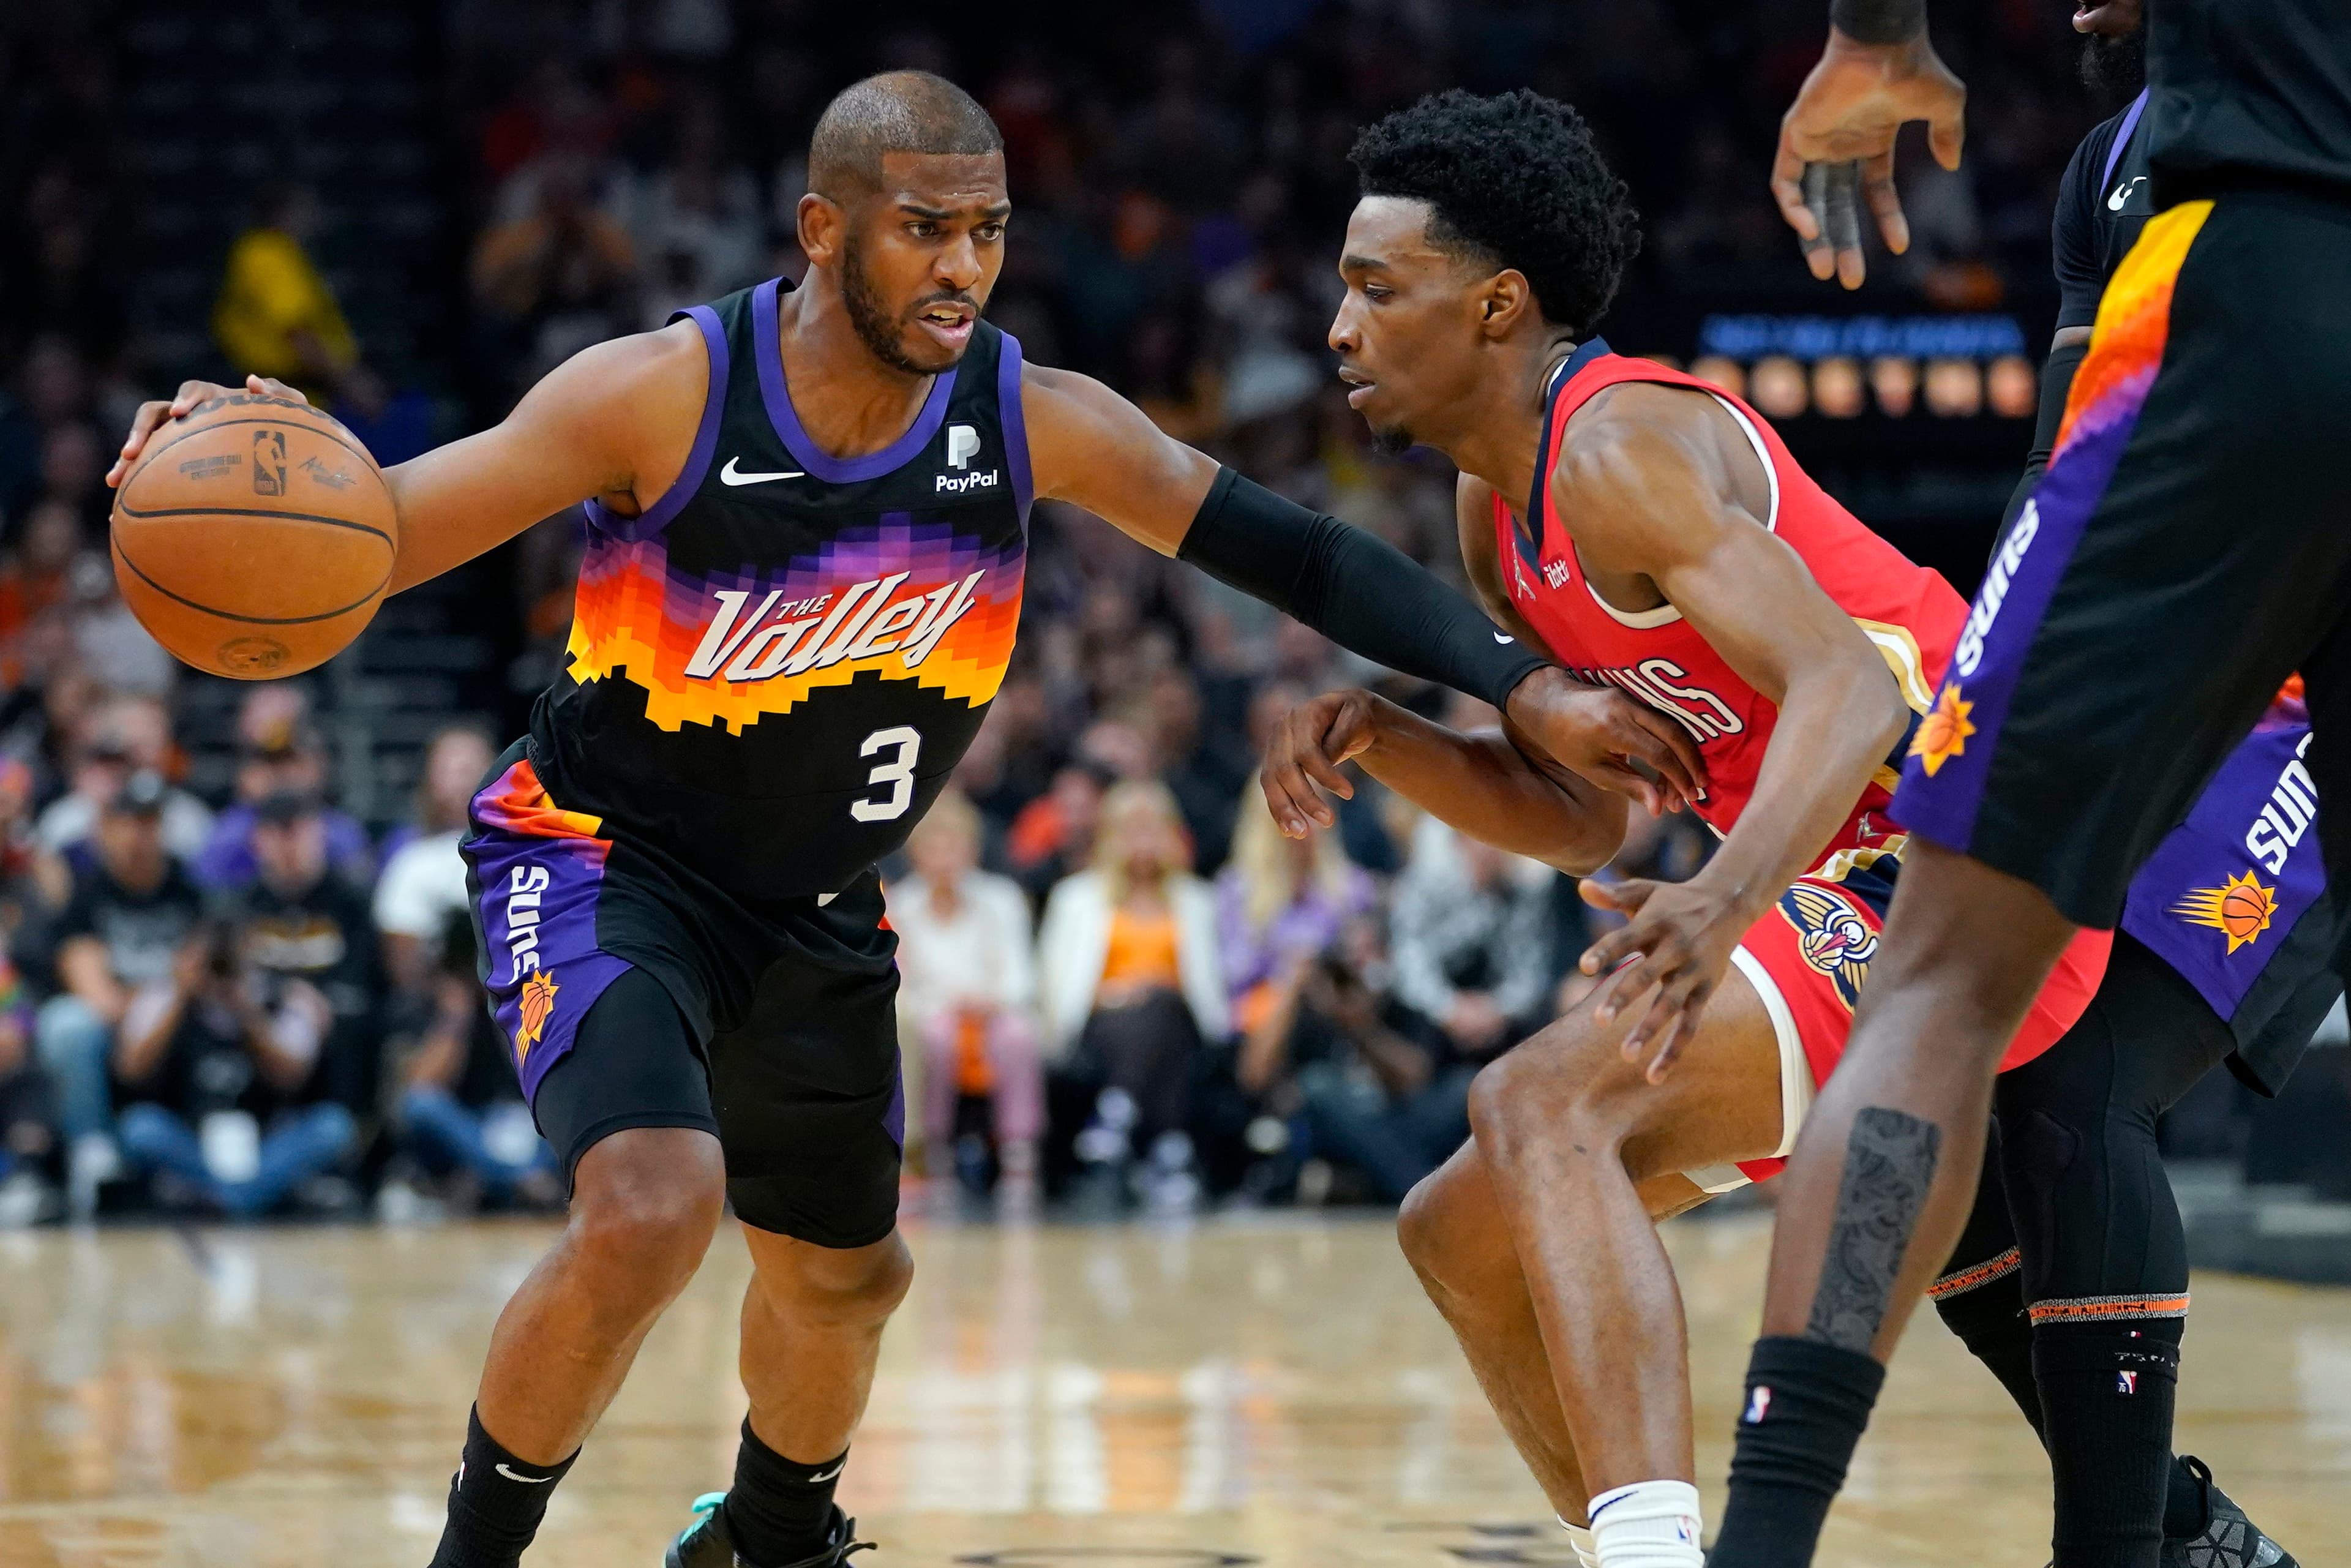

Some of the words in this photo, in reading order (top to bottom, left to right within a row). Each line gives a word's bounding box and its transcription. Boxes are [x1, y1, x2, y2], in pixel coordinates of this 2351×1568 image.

[936, 469, 997, 492] PayPal
[684, 569, 986, 683] Valley
[775, 593, 833, 620] THE
[850, 724, 923, 823] 3
